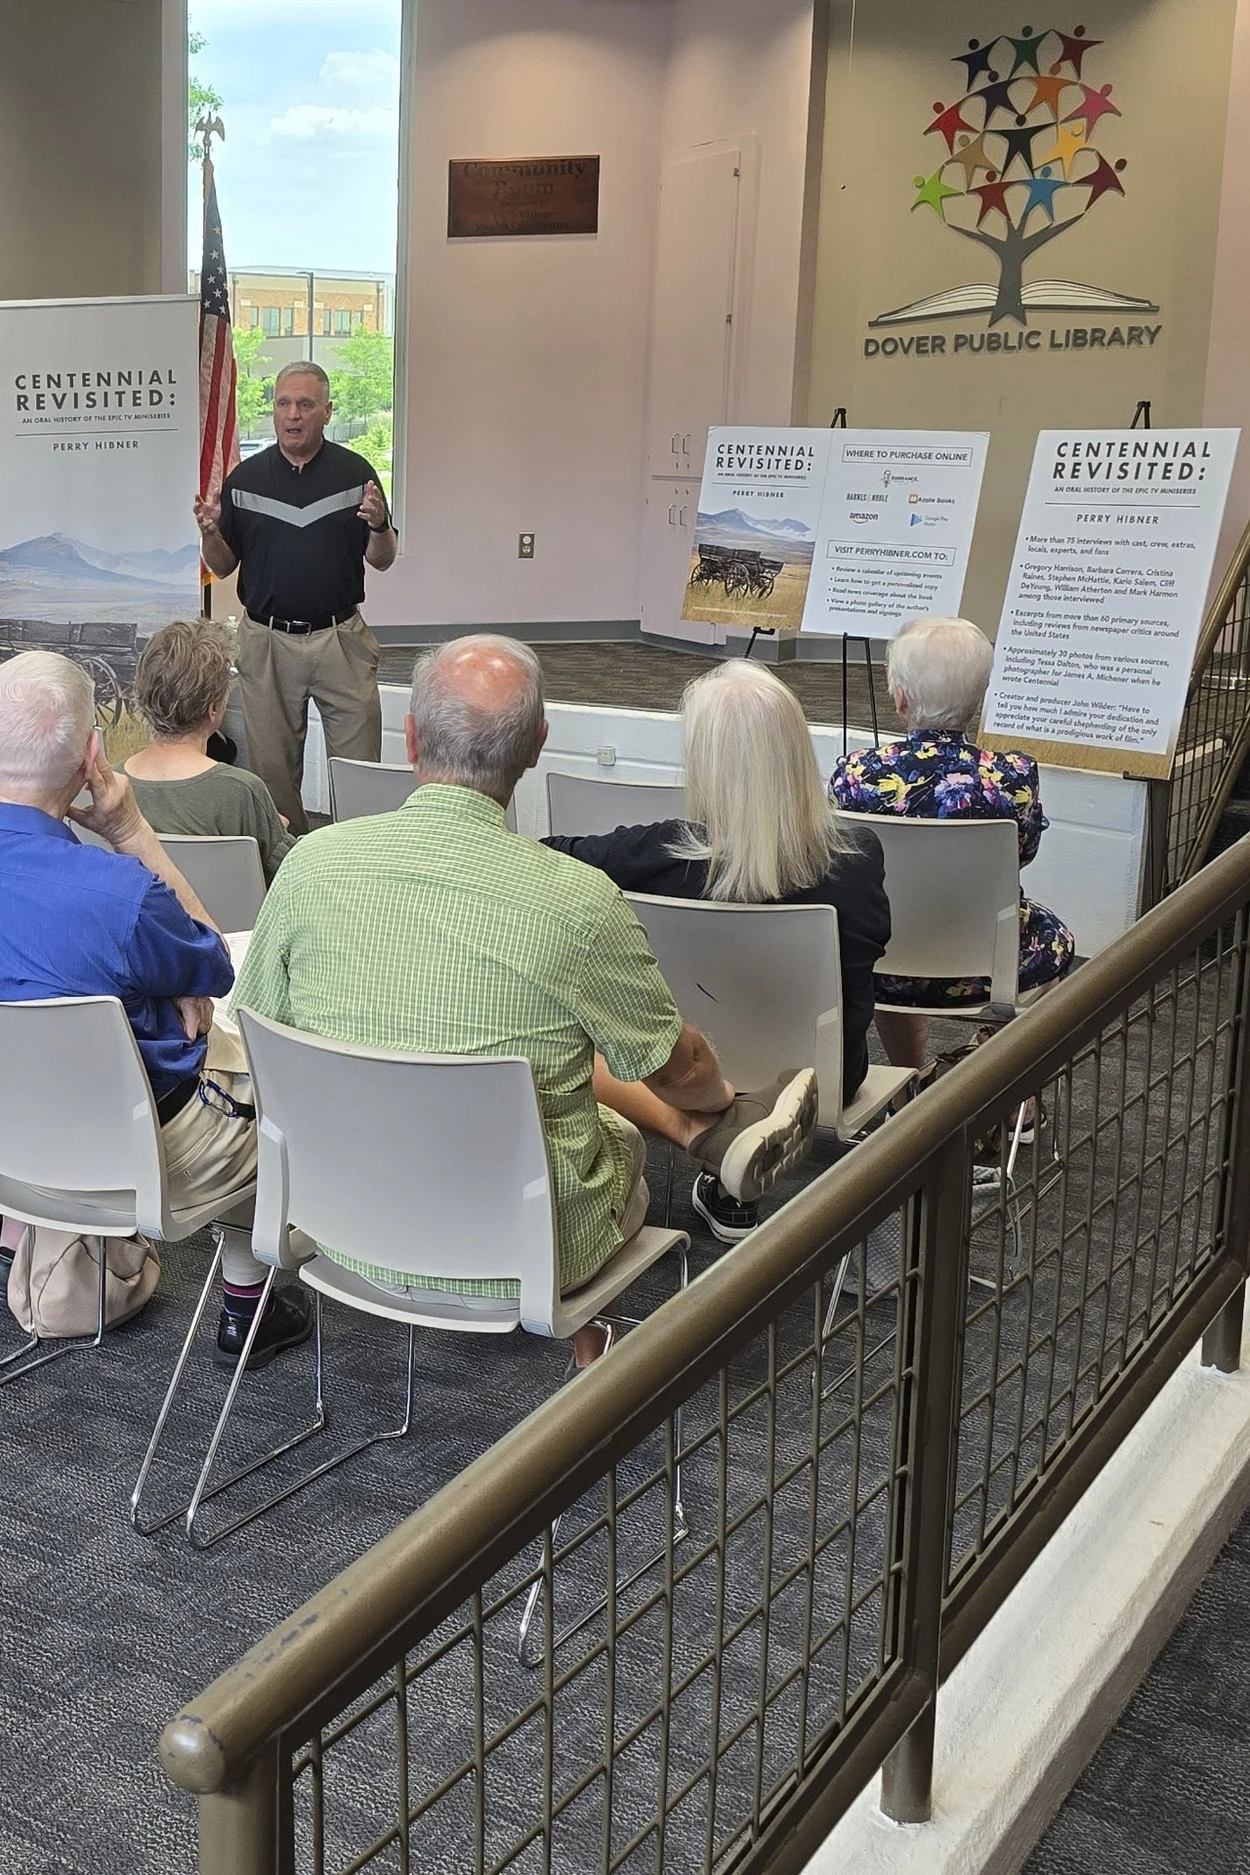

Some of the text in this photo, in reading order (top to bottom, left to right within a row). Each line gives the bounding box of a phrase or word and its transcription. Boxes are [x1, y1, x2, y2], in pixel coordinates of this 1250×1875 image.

[863, 325, 1162, 357] DOVER PUBLIC LIBRARY
[14, 368, 177, 391] CENTENNIAL
[16, 389, 176, 412] REVISITED:
[107, 414, 123, 422] EPIC
[133, 412, 171, 420] MINISERIES
[53, 440, 139, 452] PERRY HIBNER
[717, 443, 815, 458] CENTENNIAL
[1056, 441, 1211, 458] CENTENNIAL
[845, 449, 969, 461] WHERE TO PURCHASE ONLINE
[715, 456, 812, 472] REVISITED:
[1052, 461, 1206, 481] REVISITED:
[732, 489, 755, 497] PERRY
[1134, 487, 1149, 495] EPIC
[1159, 487, 1197, 495] MINISERIES
[849, 512, 879, 521] amazon
[1076, 513, 1159, 525] PERRY HIBNER
[1027, 544, 1110, 556] locals, experts, and fans
[1029, 535, 1049, 544] More
[1049, 535, 1065, 544] than
[1066, 536, 1076, 545] 75
[1075, 536, 1113, 546] interviews
[1113, 538, 1131, 547] with
[1131, 540, 1149, 548] cast,
[1170, 541, 1196, 550] extras,
[834, 545, 855, 554] VISIT
[854, 547, 933, 559] PERRYHIBNER.COM
[1024, 562, 1174, 578] Gregory Harrison, Barbara Carrera, Cristina
[1047, 573, 1076, 583] Stephen
[1159, 579, 1176, 588] Cliff
[1017, 592, 1106, 604] among those interviewed
[1080, 585, 1113, 594] Atherton
[1113, 586, 1128, 595] and
[1128, 587, 1149, 597] Mark
[1148, 588, 1179, 598] Harmon
[1014, 608, 1170, 628] Excerpts from more than 60 primary sources,
[1011, 628, 1070, 640] the United States
[1012, 618, 1180, 638] including reviews from newspaper critics around
[1007, 645, 1170, 668] Approximately 30 photos from various sources,
[1005, 655, 1036, 667] including
[1037, 657, 1056, 667] Tessa
[1082, 661, 1099, 671] who
[1099, 663, 1116, 672] was
[1120, 667, 1154, 676] personal
[1003, 664, 1051, 677] photographer
[1051, 668, 1063, 677] for
[1062, 670, 1085, 680] James
[1095, 672, 1130, 684] Michener
[1130, 676, 1151, 686] when
[1151, 677, 1162, 687] he
[1023, 676, 1060, 687] Centennial
[998, 691, 1025, 701] Creator
[1025, 695, 1040, 703] and
[1039, 696, 1072, 706] producer
[1071, 699, 1090, 708] John
[1141, 707, 1151, 715] to
[997, 701, 1009, 709] tell
[1008, 704, 1023, 712] you
[1022, 703, 1039, 712] how
[1038, 706, 1058, 715] much
[1062, 708, 1088, 718] admire
[1088, 712, 1106, 721] your
[1106, 712, 1144, 725] dedication
[1144, 717, 1160, 726] and
[993, 721, 1016, 729] record
[1016, 722, 1025, 730] of
[1025, 724, 1043, 733] what
[1043, 725, 1050, 733] is
[1055, 728, 1094, 739] prodigious
[1095, 732, 1114, 741] work
[1114, 733, 1124, 742] of
[994, 712, 1158, 738] appreciate your careful shepherding of the only
